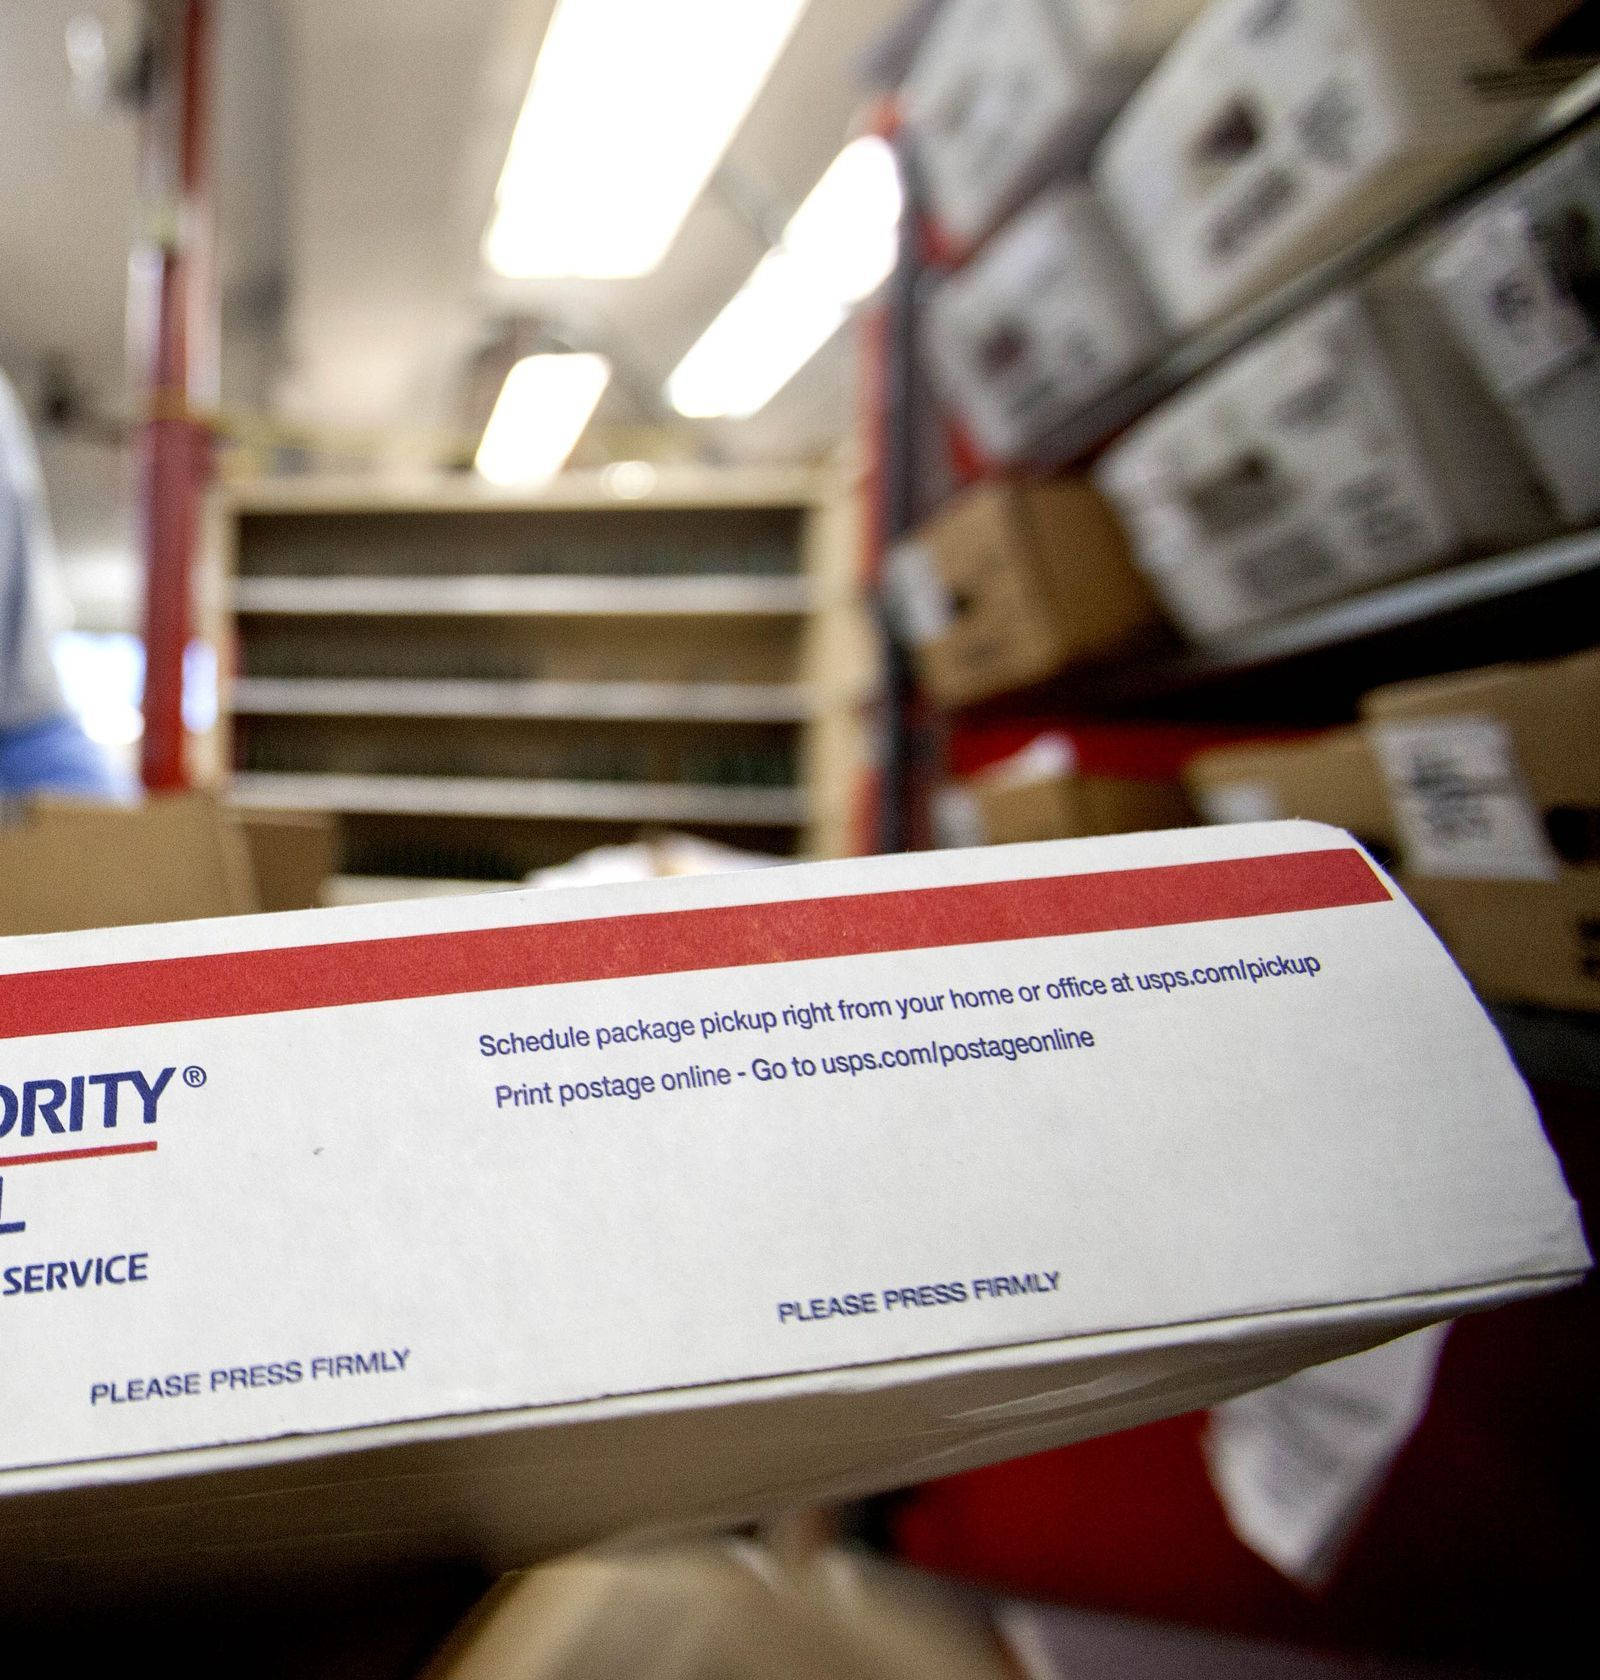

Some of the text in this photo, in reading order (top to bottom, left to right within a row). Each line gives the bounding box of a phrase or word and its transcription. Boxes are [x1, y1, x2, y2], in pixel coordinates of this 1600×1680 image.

[479, 954, 1322, 1057] Schedule package pickup right from your home or office at usps.com/pickup
[495, 1082, 554, 1109] Print
[558, 1075, 656, 1107] postage
[660, 1065, 732, 1092] online
[751, 1058, 788, 1082] Go
[790, 1056, 817, 1077] to
[821, 1027, 1096, 1077] usps.com/postageonline
[2, 1252, 149, 1297] SERVICE
[777, 1270, 1060, 1323] PLEASE PRESS FIRMLY
[90, 1349, 410, 1406] PLEASE PRESS FIRMLY
